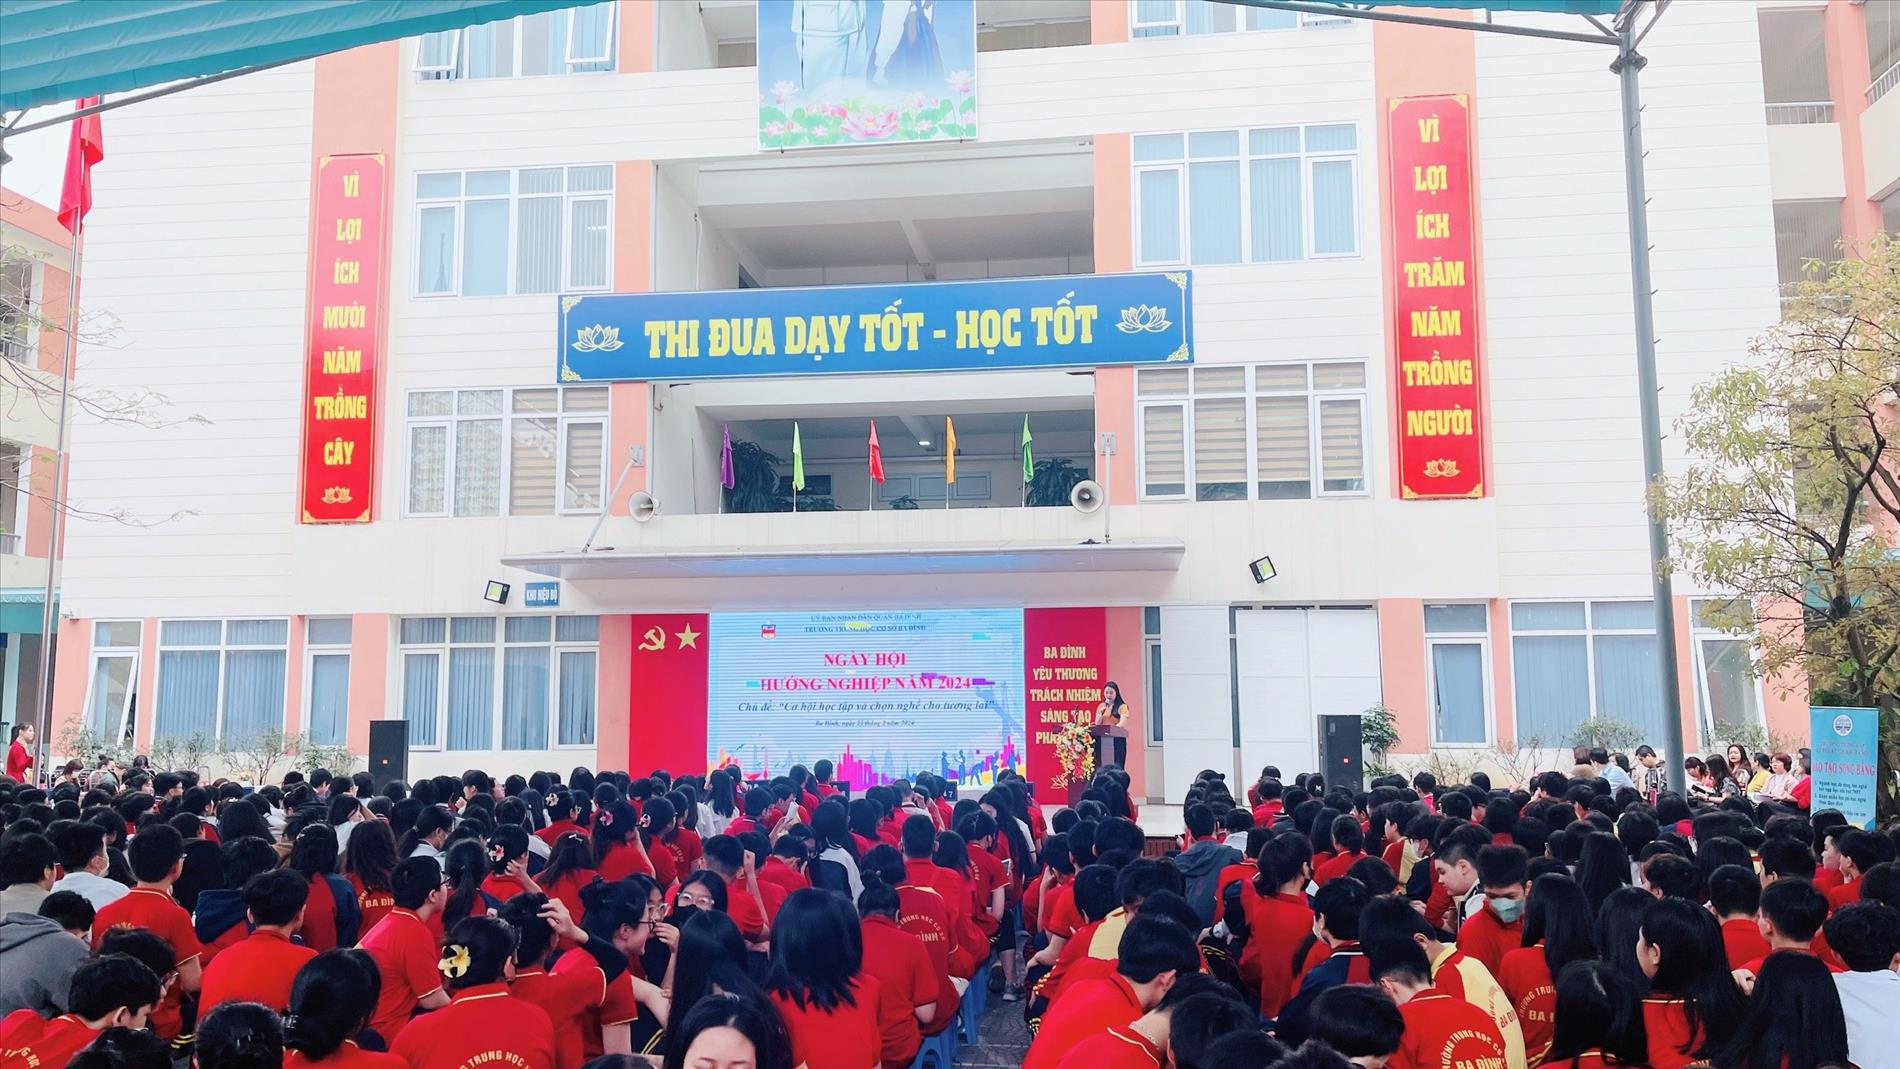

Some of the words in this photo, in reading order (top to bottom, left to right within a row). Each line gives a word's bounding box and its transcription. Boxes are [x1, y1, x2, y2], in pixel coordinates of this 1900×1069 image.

[1418, 113, 1440, 143] VÌ
[343, 170, 360, 198] VÌ
[1414, 164, 1448, 195] LỢI
[336, 218, 362, 245] LỢI
[1416, 209, 1450, 239] ÍCH
[333, 257, 360, 285] ÍCH
[1404, 256, 1465, 288] TRĂM
[323, 300, 366, 329] MƯỜI
[645, 319, 700, 358] THI
[708, 317, 776, 357] ĐUA
[784, 315, 851, 361] DẠY
[859, 298, 924, 353] TỐT
[932, 328, 947, 339] -
[956, 307, 1022, 355] HỌC
[1031, 290, 1098, 346] TỐT
[1411, 305, 1462, 337] NĂM
[322, 345, 362, 375] NĂM
[1402, 350, 1473, 387] TRỒNG
[314, 386, 367, 420] TRỒNG
[1406, 404, 1473, 437] NGƯỜI
[323, 437, 354, 466] CÂY
[824, 650, 870, 667] NGÀY
[876, 651, 906, 668] HỘI
[1043, 646, 1058, 659] BA
[1060, 644, 1086, 659] ĐÌNH
[761, 674, 823, 691] HƯỚNG
[827, 675, 891, 693] NGHIỆP
[895, 673, 934, 689] NĂM
[938, 676, 971, 689] 2024
[1033, 666, 1053, 680] YÊU
[1055, 667, 1098, 680] THƯƠNG
[801, 701, 816, 713] hội
[819, 702, 835, 713] học
[870, 701, 893, 712] chọn
[923, 701, 940, 710] cho
[1030, 687, 1063, 702] TRÁCH
[1066, 687, 1101, 704] NHIỆM
[1040, 708, 1069, 723] SÁNG
[366, 899, 379, 908] BA
[1528, 1010, 1546, 1021] BA
[467, 1049, 503, 1068] TRUNG
[504, 1051, 525, 1067] HỌC
